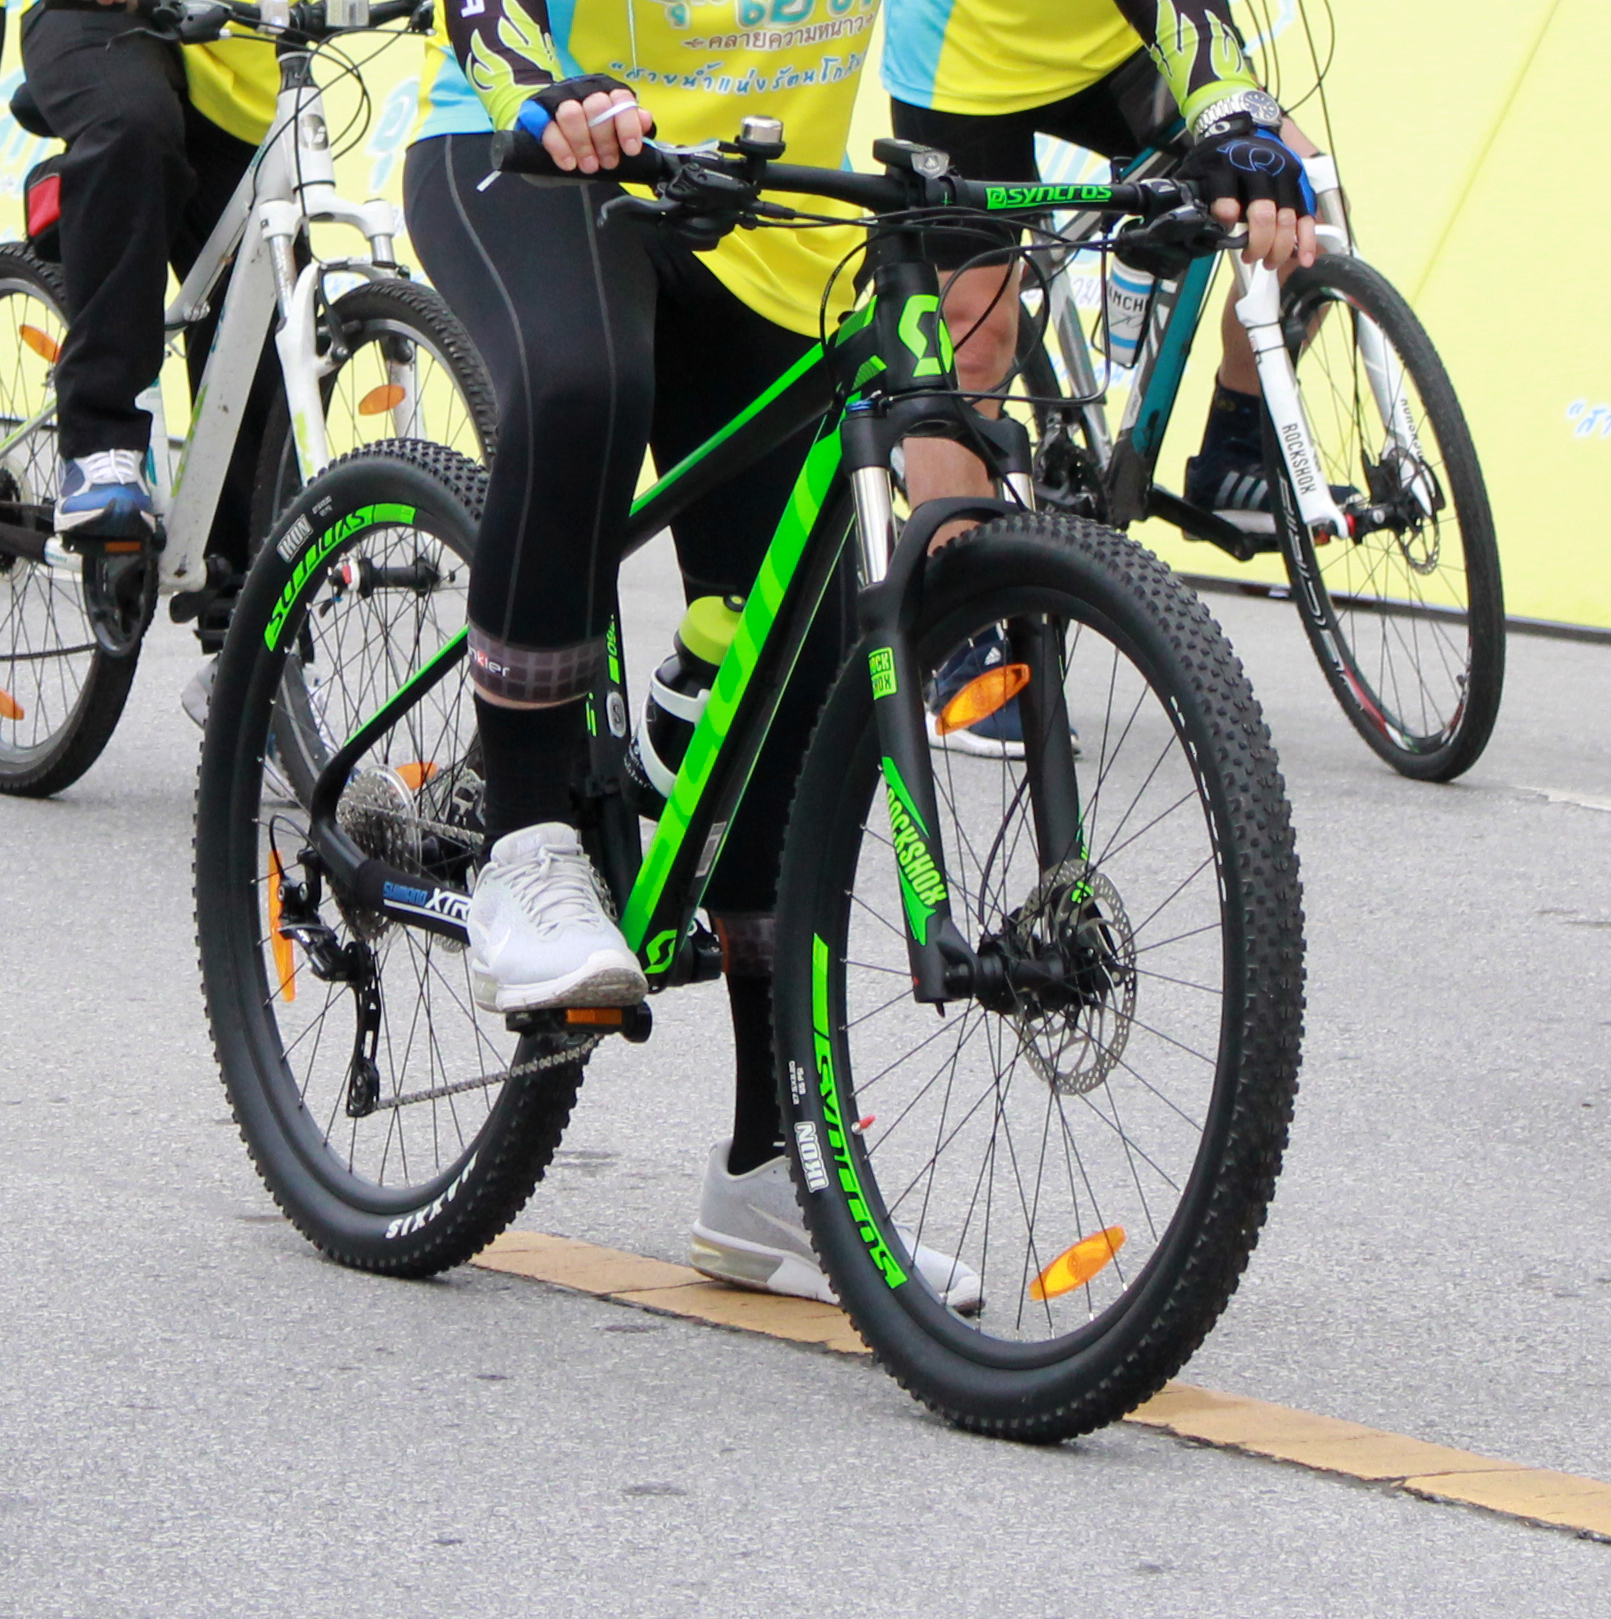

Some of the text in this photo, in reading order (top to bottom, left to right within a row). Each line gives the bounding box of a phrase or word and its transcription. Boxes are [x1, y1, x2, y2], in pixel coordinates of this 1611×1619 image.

[706, 14, 866, 51] คลายความหนาว
[1281, 422, 1317, 496] ROCKSHOX
[276, 513, 315, 564] IKON
[383, 881, 429, 907] SHIMANO
[794, 1120, 829, 1194] IKON
